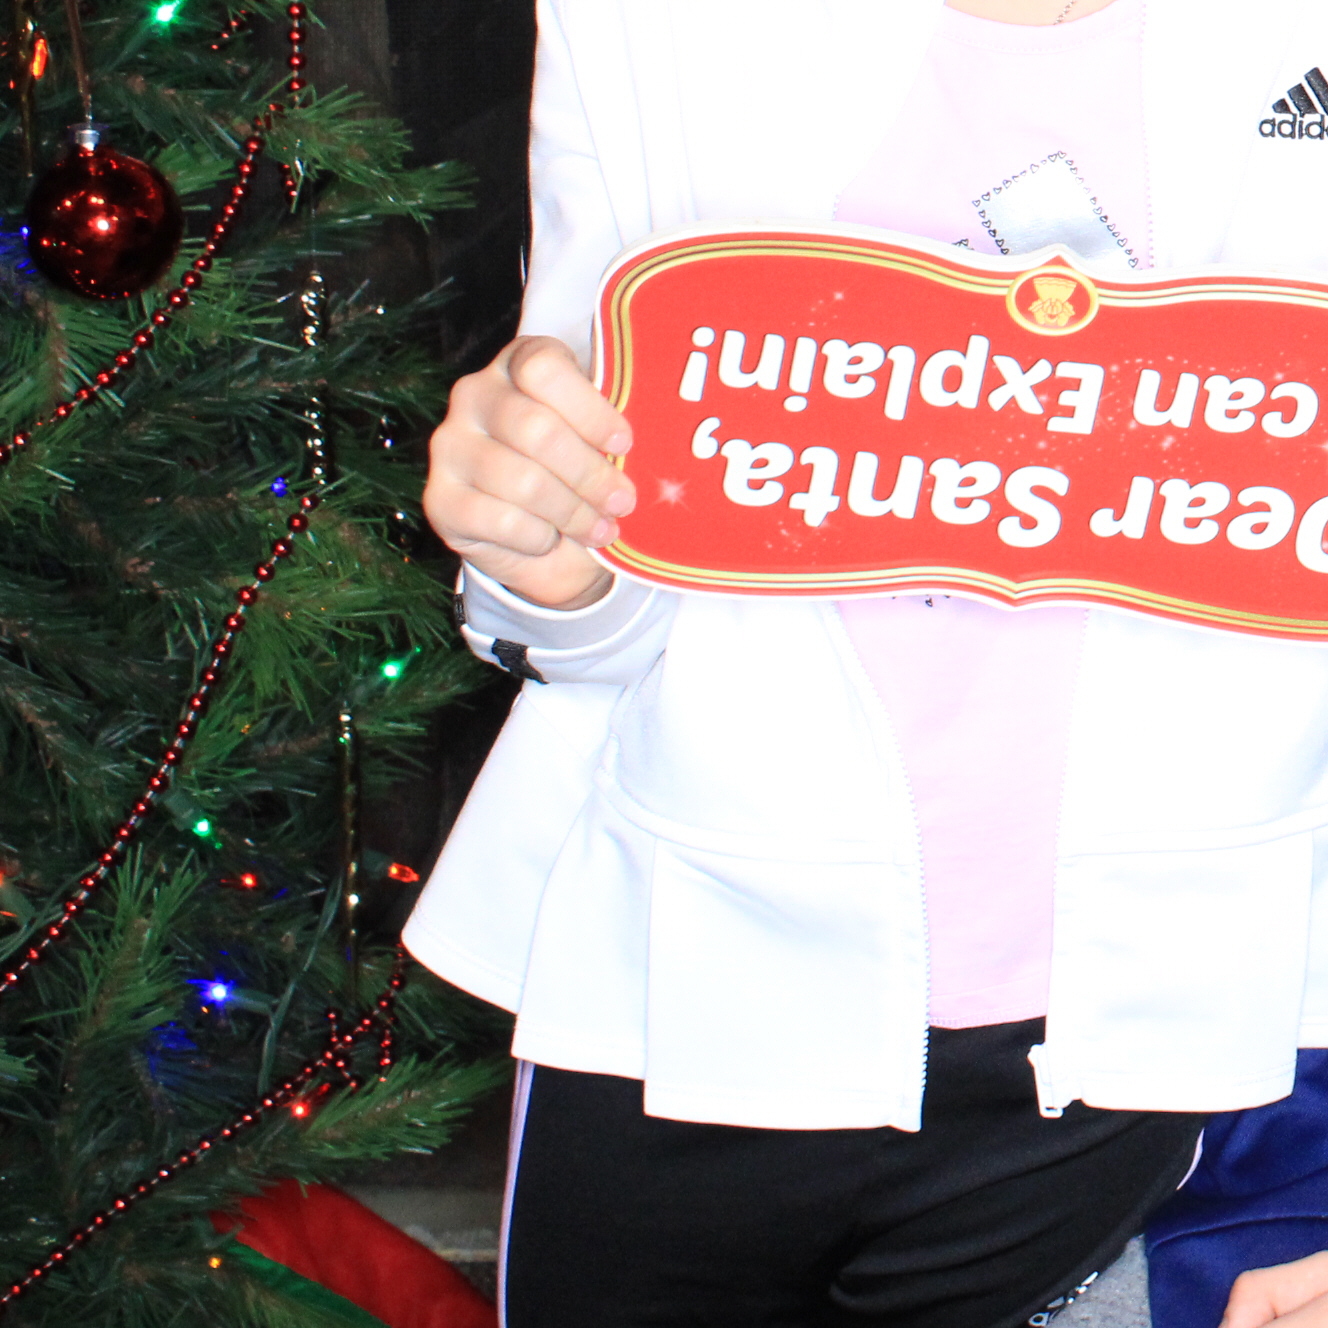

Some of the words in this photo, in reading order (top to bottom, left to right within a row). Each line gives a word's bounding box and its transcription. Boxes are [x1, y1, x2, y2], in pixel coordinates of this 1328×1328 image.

[678, 325, 1106, 436] Explain!
[1132, 368, 1320, 439] can
[691, 416, 1071, 549] Santa,
